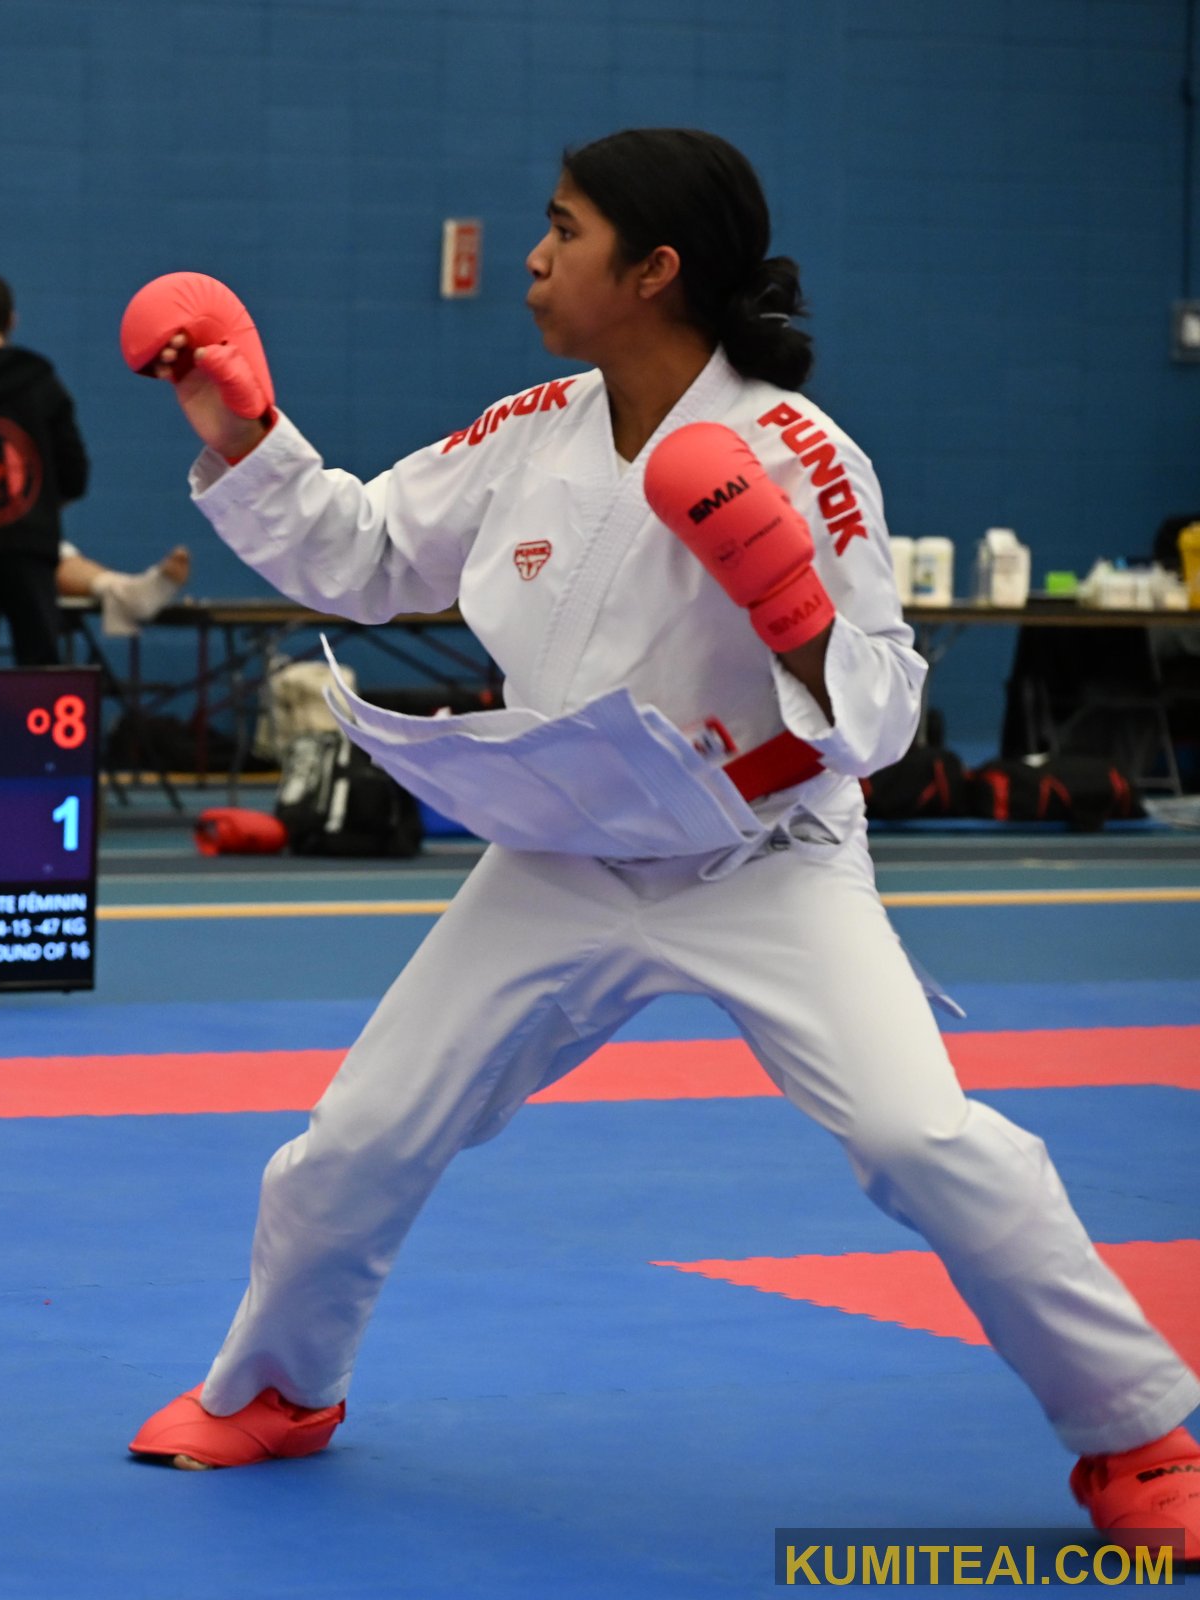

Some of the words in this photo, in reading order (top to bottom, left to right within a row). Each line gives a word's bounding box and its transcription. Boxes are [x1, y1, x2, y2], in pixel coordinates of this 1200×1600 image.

[441, 379, 576, 455] PUNOK
[688, 475, 750, 525] SMAI
[756, 402, 869, 557] PUNOK
[767, 594, 823, 636] SMAI
[52, 795, 79, 851] 1
[17, 890, 87, 914] FÉMININ
[62, 916, 87, 937] KG
[43, 941, 68, 961] OF
[70, 940, 91, 960] 16
